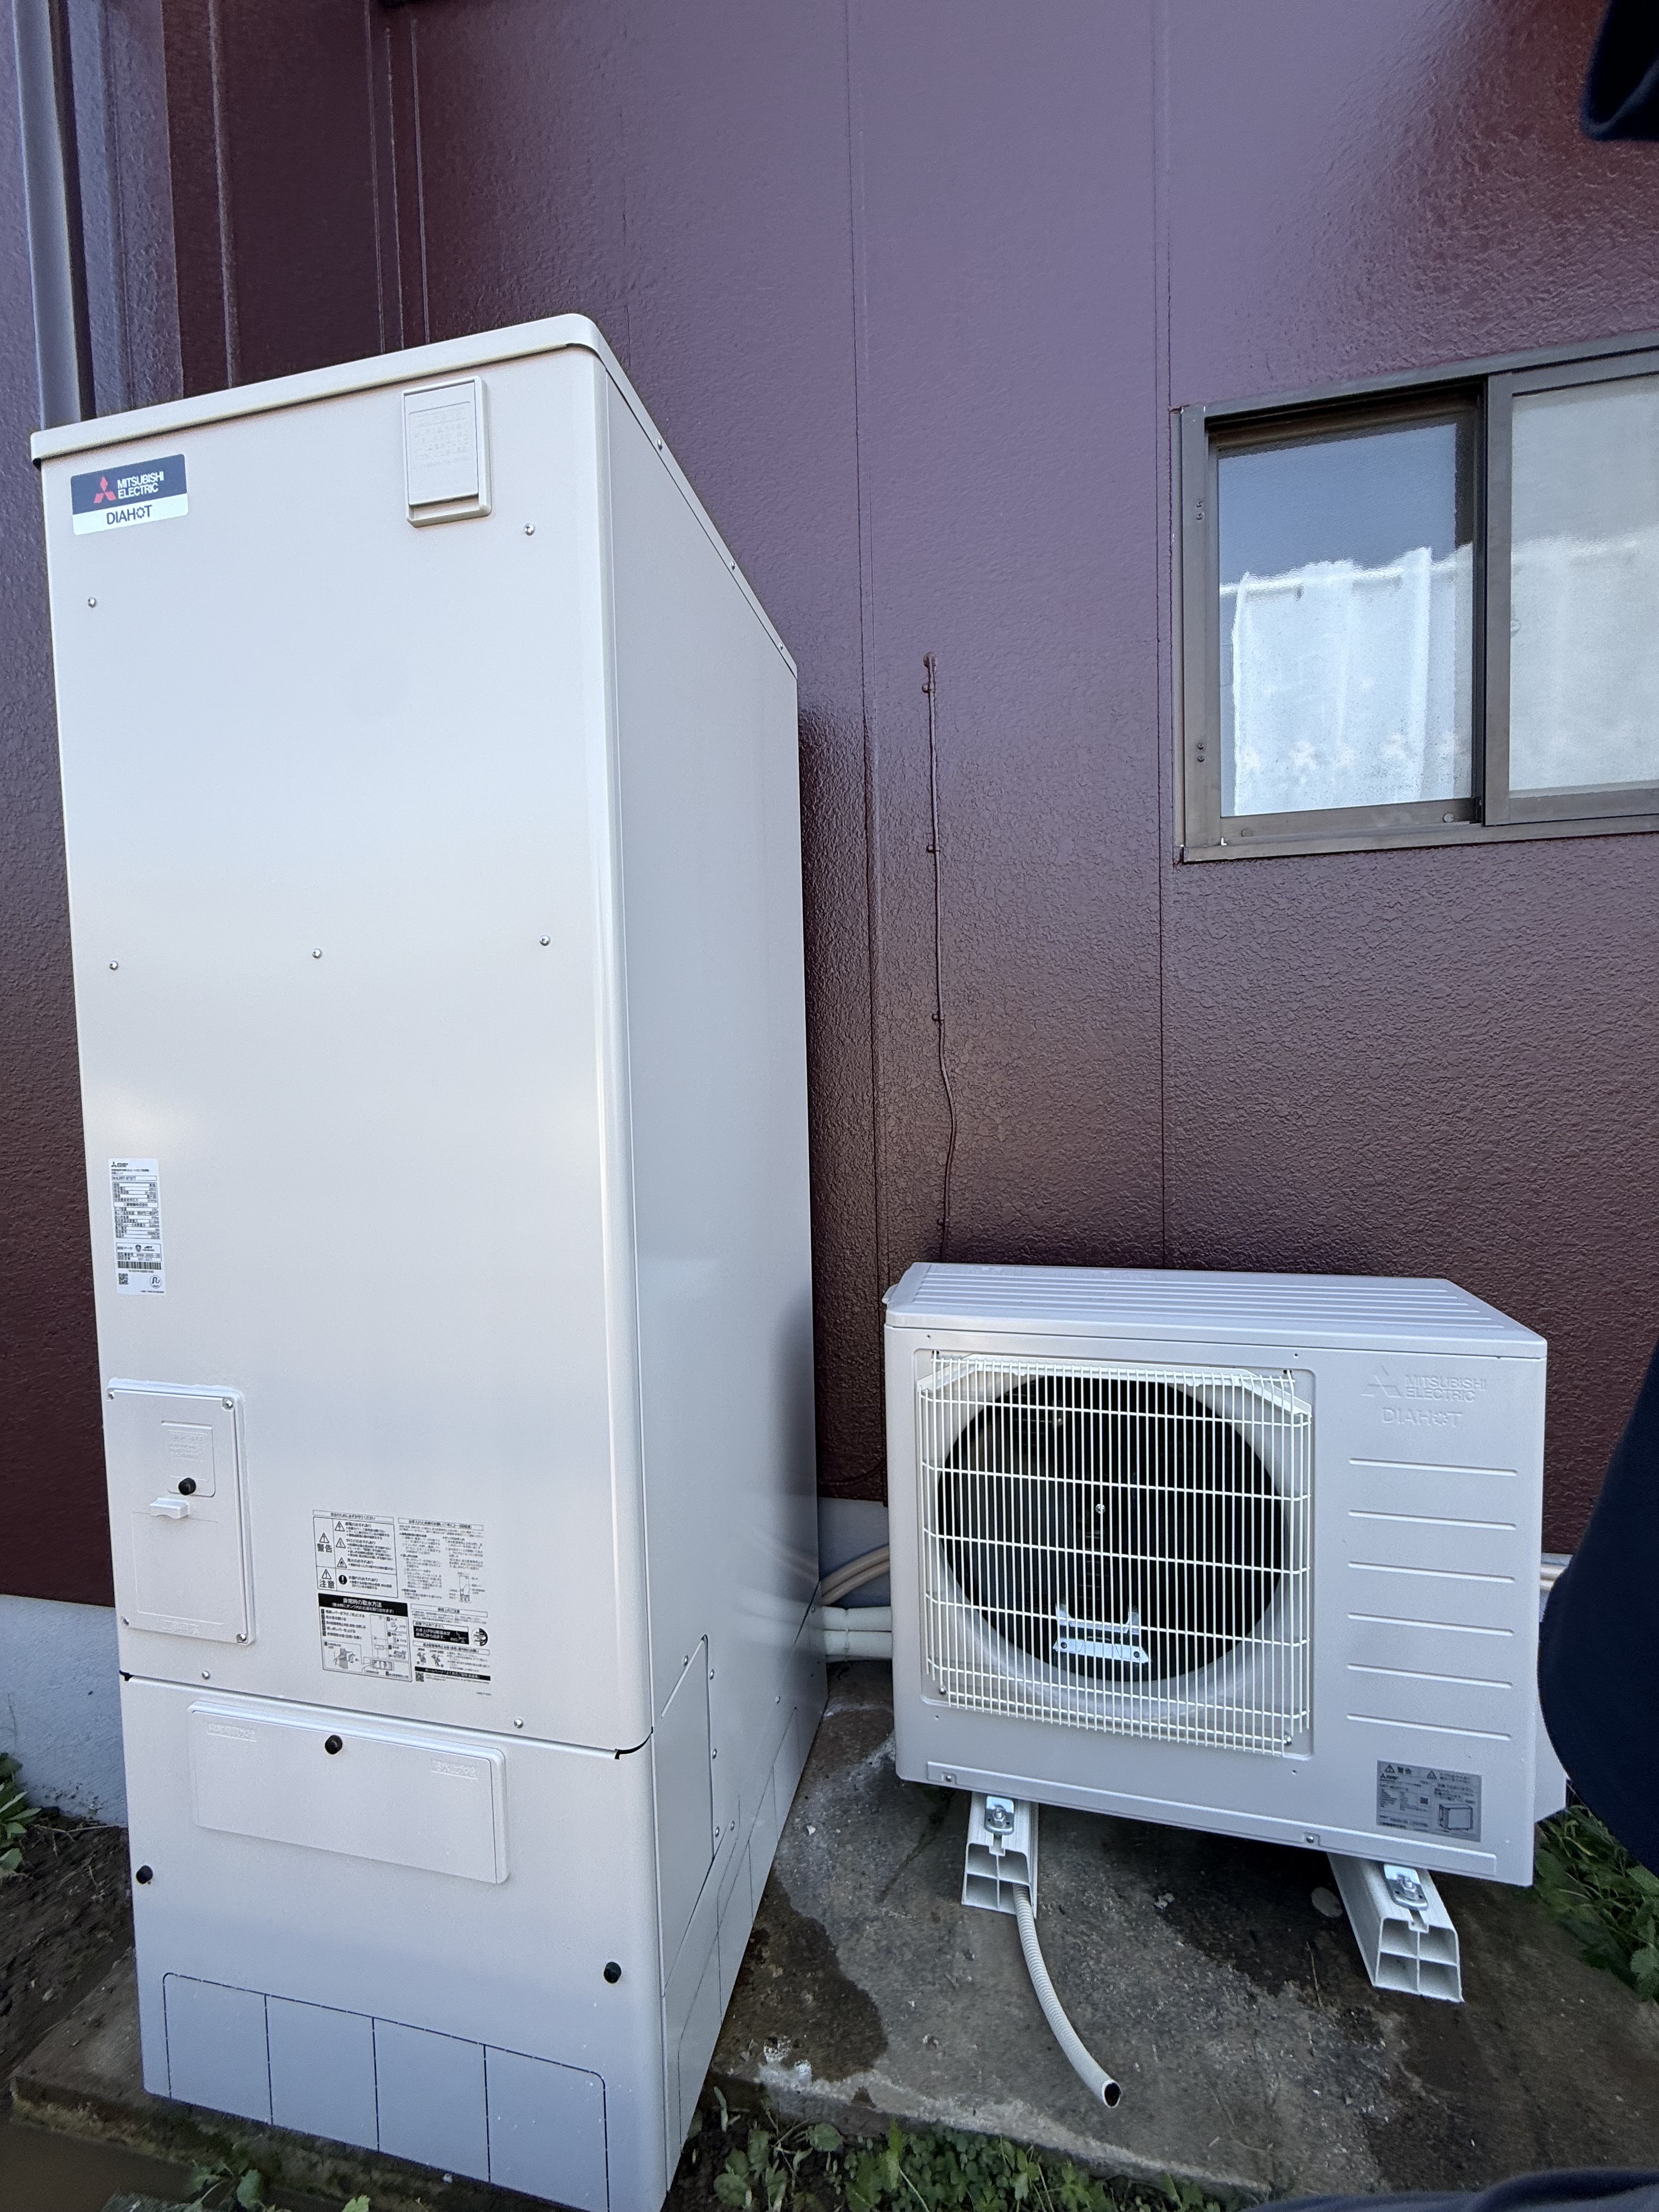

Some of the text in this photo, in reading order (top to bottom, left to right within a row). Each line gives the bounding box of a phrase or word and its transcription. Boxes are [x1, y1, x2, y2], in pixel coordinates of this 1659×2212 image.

[117, 471, 164, 489] MITSUBISHI
[118, 482, 159, 499] ELECTRIC
[106, 505, 153, 525] DIAHOT
[1404, 1374, 1487, 1391] MITSUBISHI
[1405, 1386, 1476, 1403] ELECTRIC
[1382, 1407, 1462, 1427] DIAHOT
[317, 1543, 332, 1553] 警告
[319, 1579, 335, 1589] 注意
